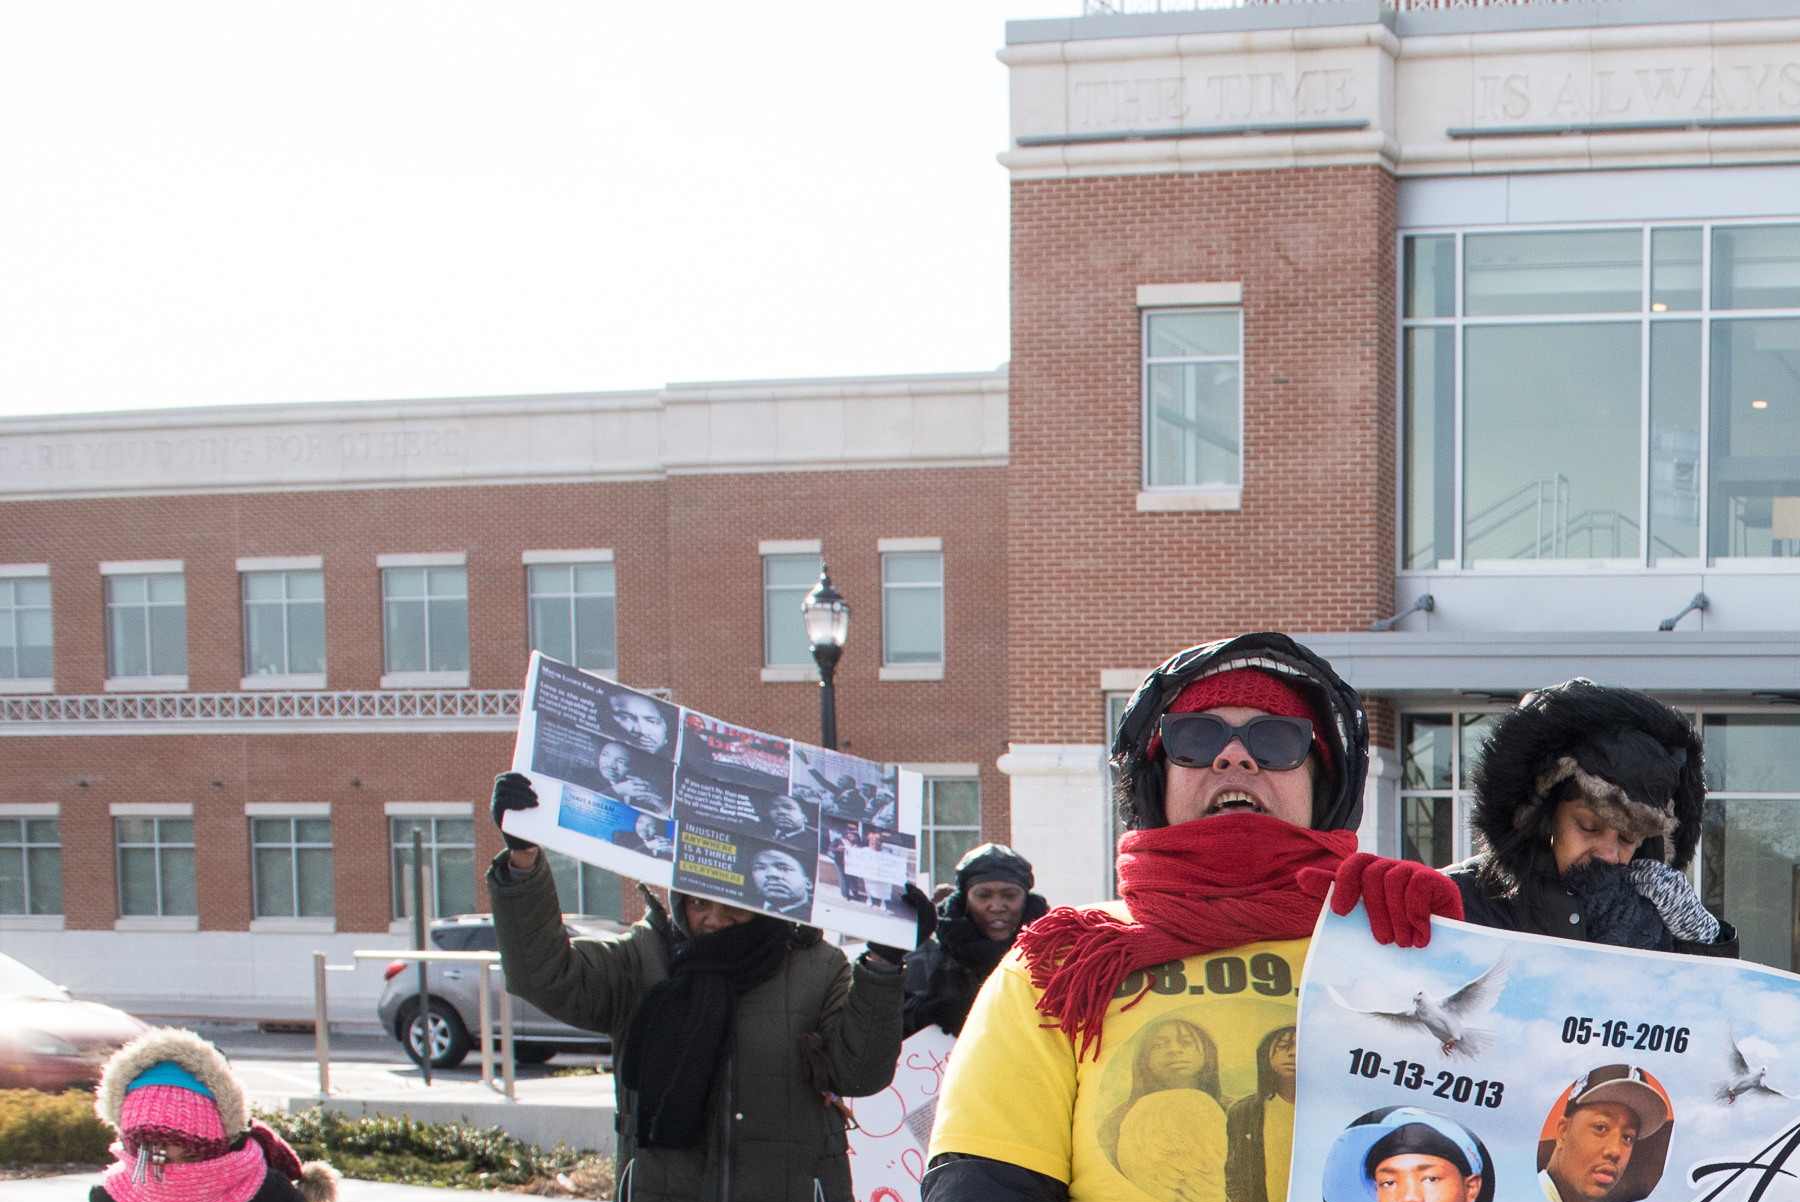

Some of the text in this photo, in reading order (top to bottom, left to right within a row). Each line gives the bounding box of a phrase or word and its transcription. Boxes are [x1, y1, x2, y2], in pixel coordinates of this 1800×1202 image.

[1074, 68, 1357, 126] THE TIME
[1478, 73, 1531, 121] IS
[685, 823, 731, 843] INJUSTICE
[684, 834, 734, 853] ANYWHERE
[684, 844, 737, 863] IS A THREAT
[682, 862, 741, 882] EVERYWHERE
[683, 853, 733, 871] TO JUSTICE
[1561, 1016, 1690, 1054] 05-16-2016
[1349, 1047, 1505, 1109] 10-13-2013
